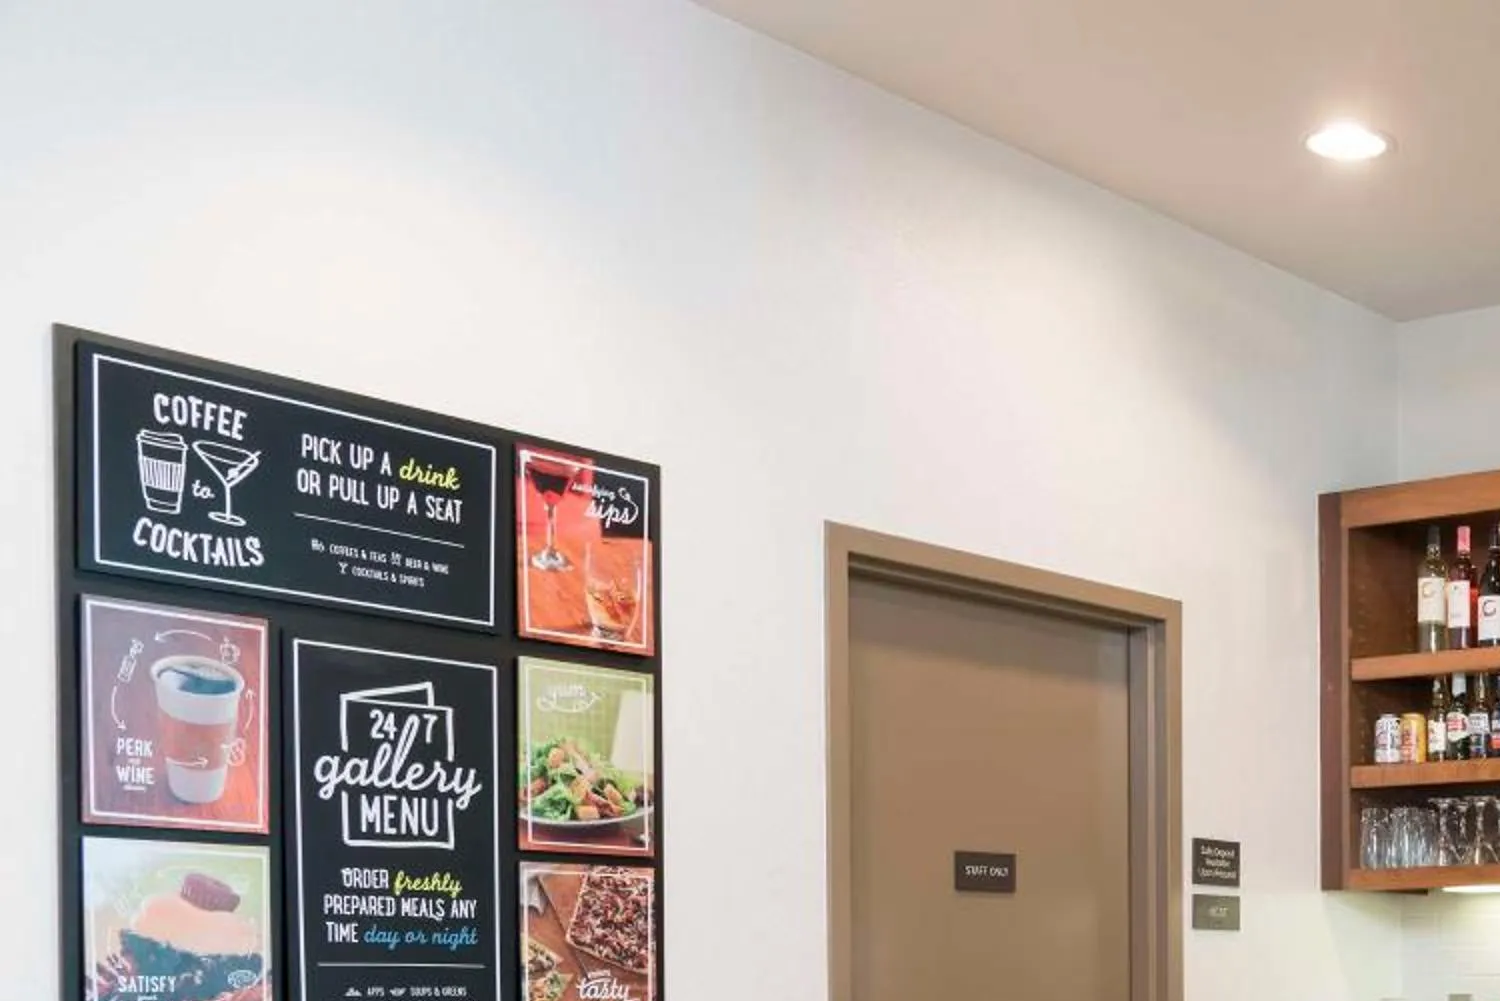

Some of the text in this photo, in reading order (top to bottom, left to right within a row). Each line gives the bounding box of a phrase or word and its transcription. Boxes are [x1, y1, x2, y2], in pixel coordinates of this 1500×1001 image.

[153, 393, 247, 441] COFFEE
[301, 433, 461, 491] PICK UP A drink
[191, 479, 215, 499] to
[297, 468, 463, 525] OR PULL UP A SEAT
[584, 487, 639, 529] sips
[133, 517, 264, 566] COCKTAILS
[115, 764, 155, 785] WINE
[314, 713, 483, 811] gallery
[360, 793, 440, 837] MENU
[341, 867, 463, 898] ORDER freshly
[323, 893, 478, 922] PREPARED MEALS ANY
[325, 921, 479, 951] TIME day or night
[118, 975, 177, 993] SATISFY
